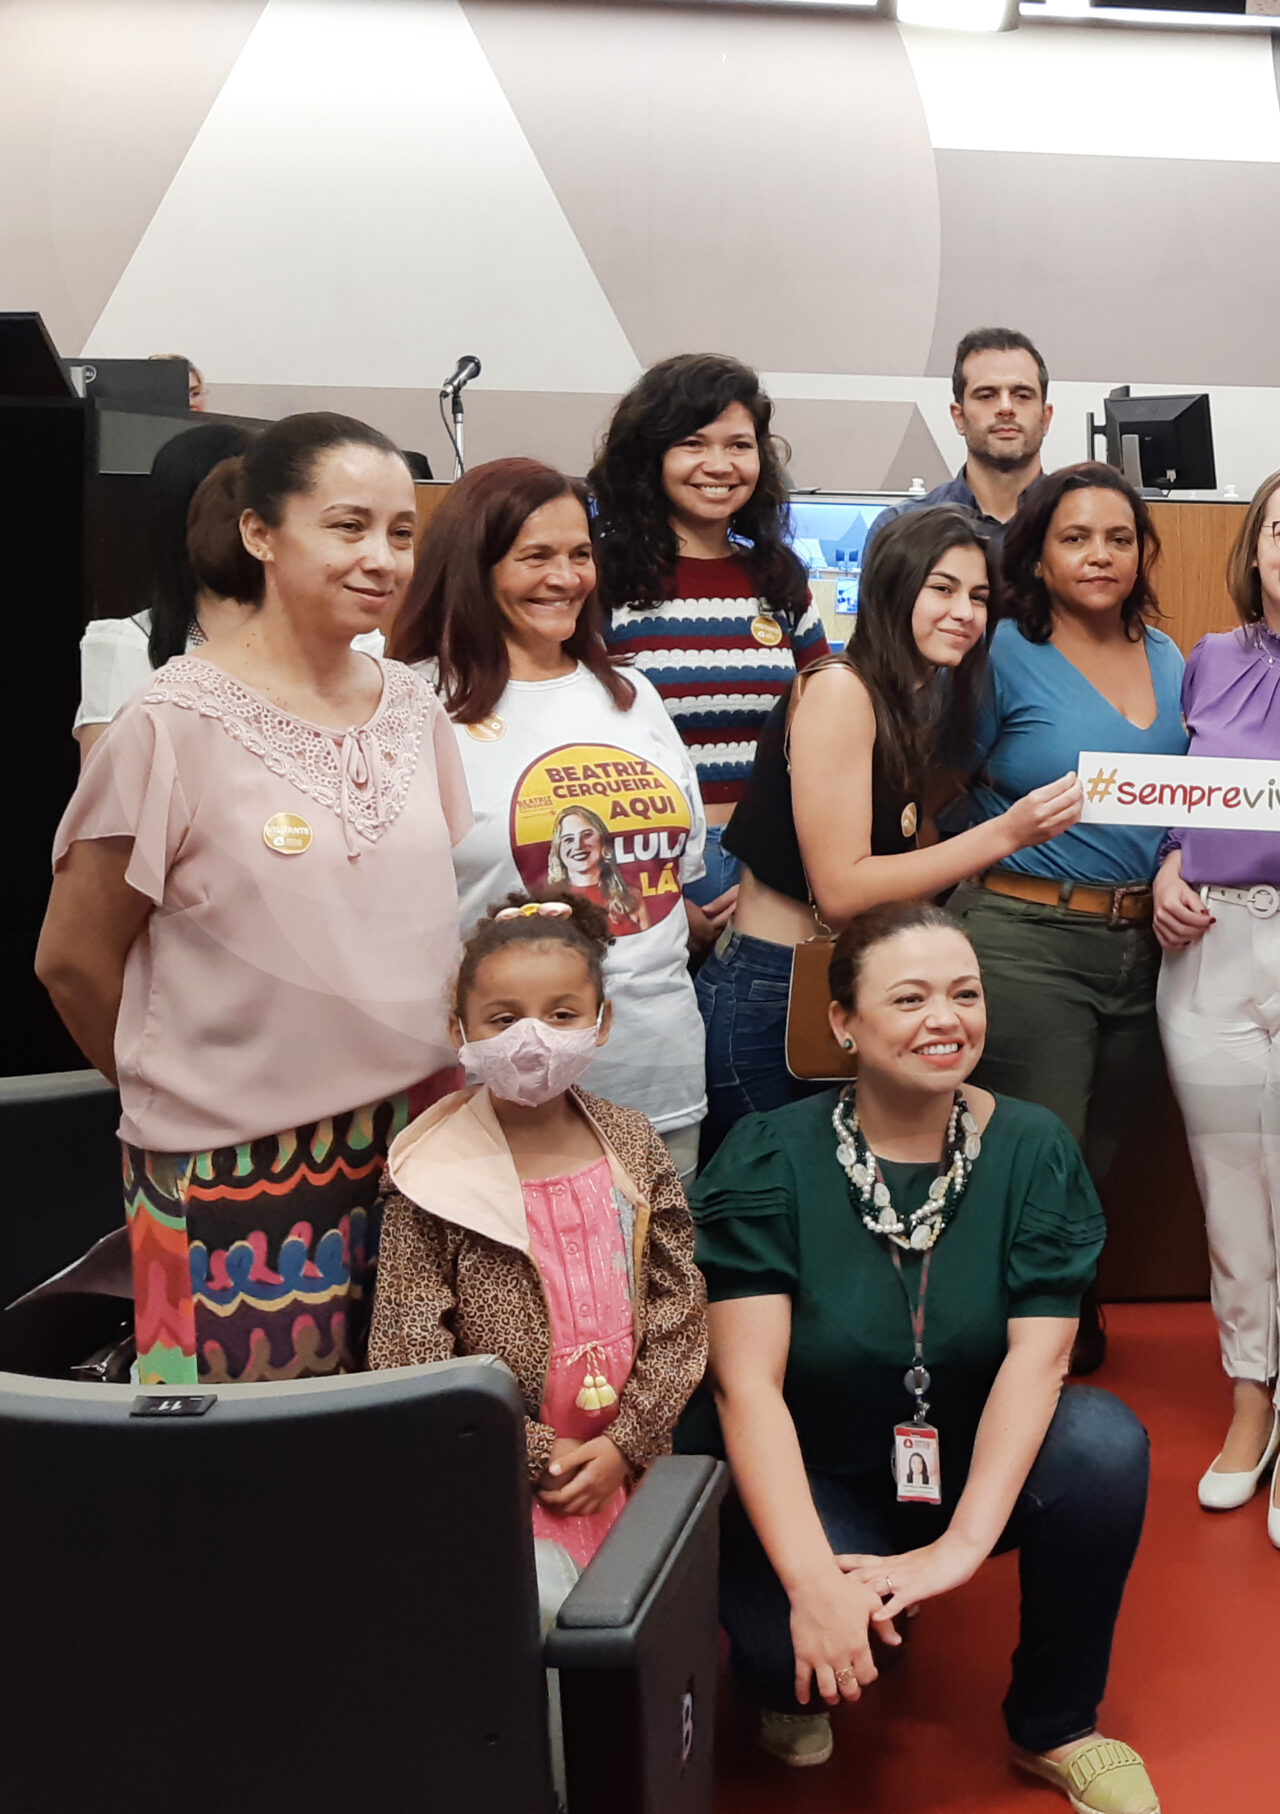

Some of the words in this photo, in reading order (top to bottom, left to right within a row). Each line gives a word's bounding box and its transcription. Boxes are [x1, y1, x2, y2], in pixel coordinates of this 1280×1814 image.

[544, 759, 654, 783] BEATRIZ
[552, 777, 667, 799] CERQUEIRA
[609, 795, 677, 820] AQUI
[639, 862, 680, 897] LÁ
[158, 1400, 182, 1411] 11
[682, 1693, 693, 1761] B
